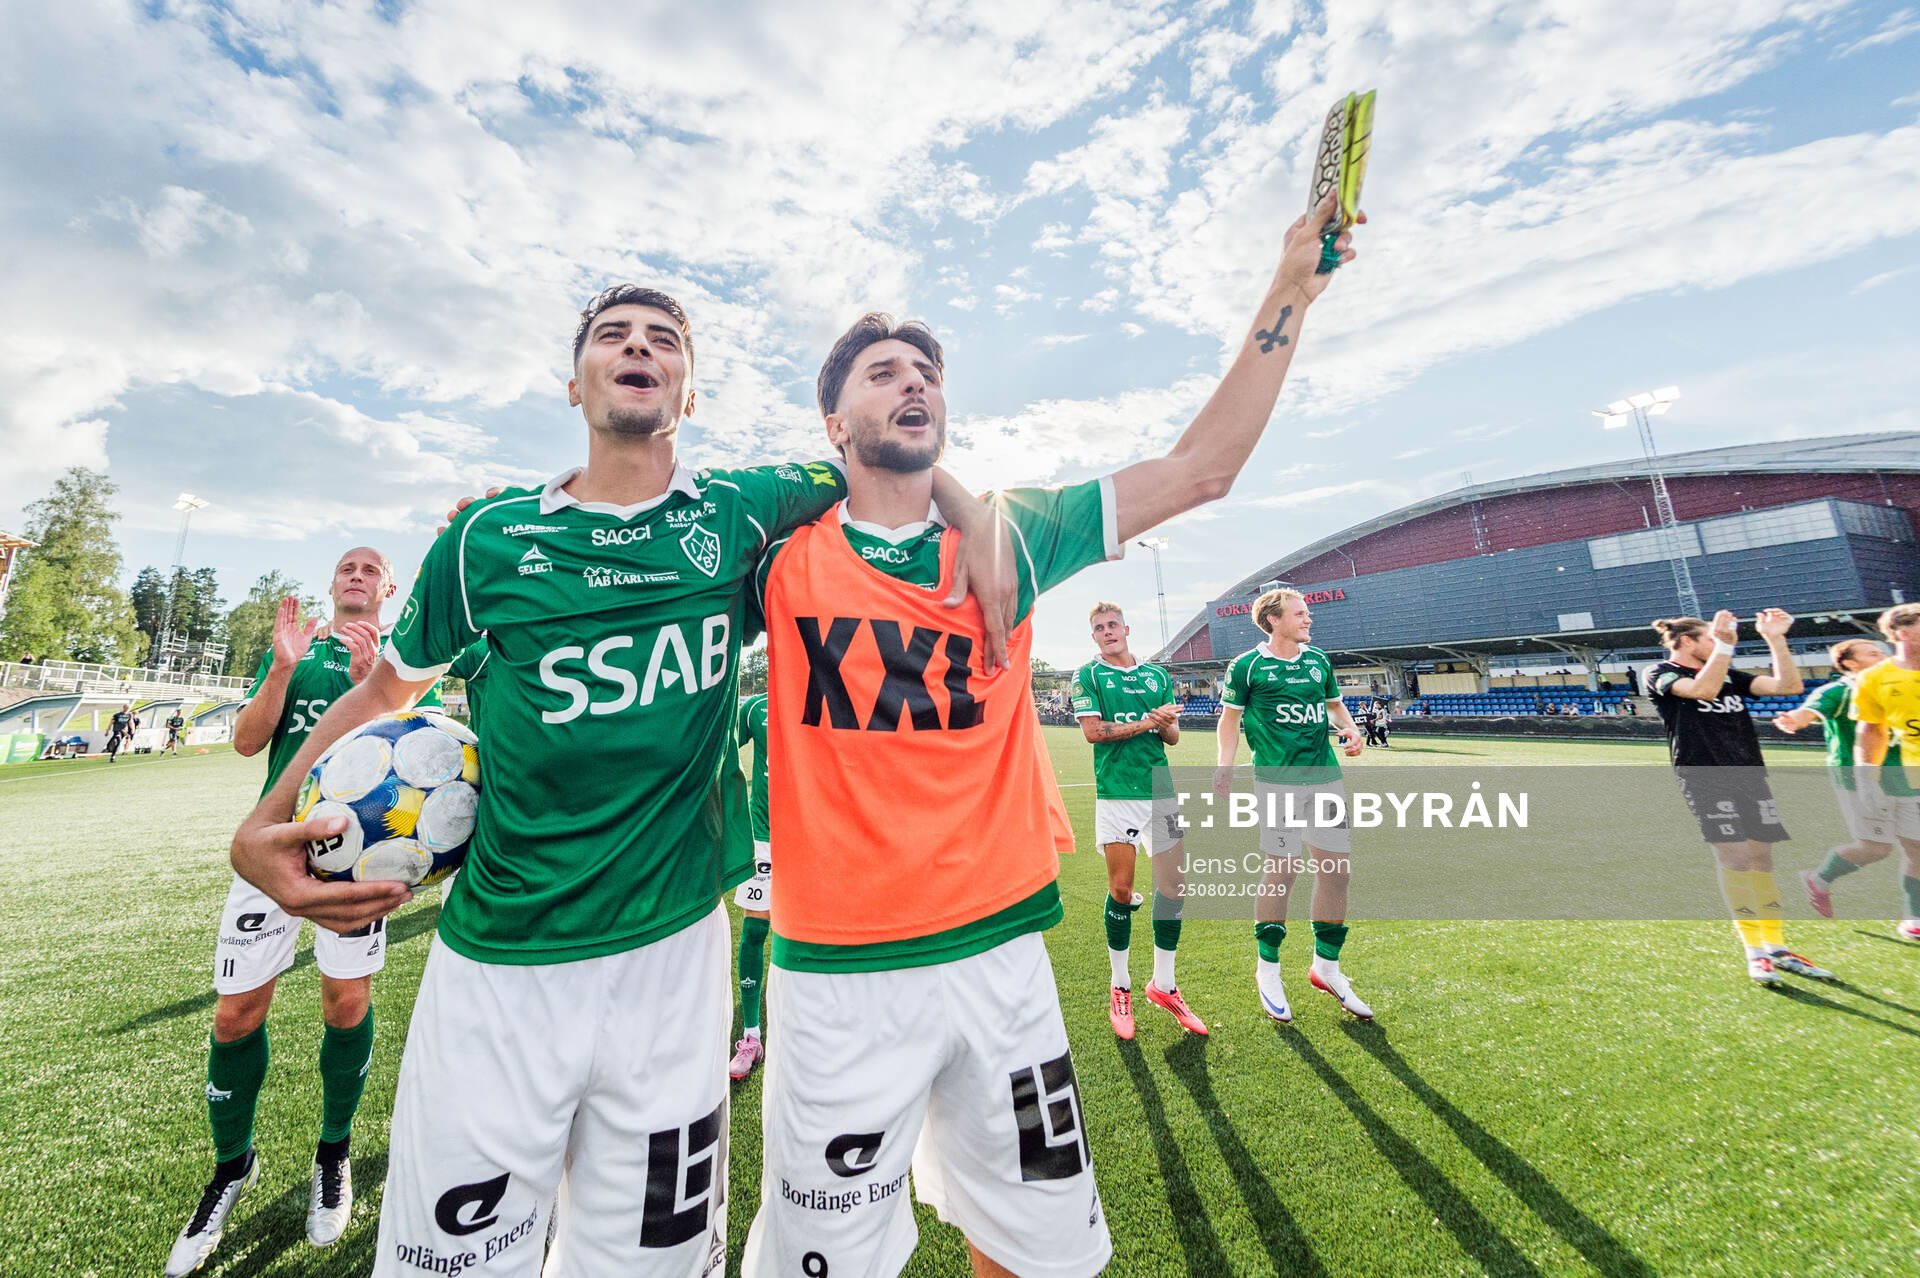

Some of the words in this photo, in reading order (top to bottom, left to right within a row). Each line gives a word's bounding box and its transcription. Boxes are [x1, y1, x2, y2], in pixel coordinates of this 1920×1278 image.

[591, 525, 651, 546] SACCI
[518, 562, 553, 576] SELECT
[613, 573, 643, 586] KARL
[1304, 588, 1345, 605] RENA
[539, 613, 730, 724] SSAB
[795, 616, 985, 732] XXL
[287, 699, 328, 734] SS
[1906, 719, 1920, 737] S
[1278, 836, 1286, 848] 3
[747, 886, 763, 901] 20
[221, 935, 252, 946] orlänge
[222, 958, 235, 978] 11
[781, 1178, 862, 1214] Borlänge
[868, 1174, 906, 1204] Ener
[395, 1244, 477, 1278] orlänge
[801, 1250, 829, 1278] 9
